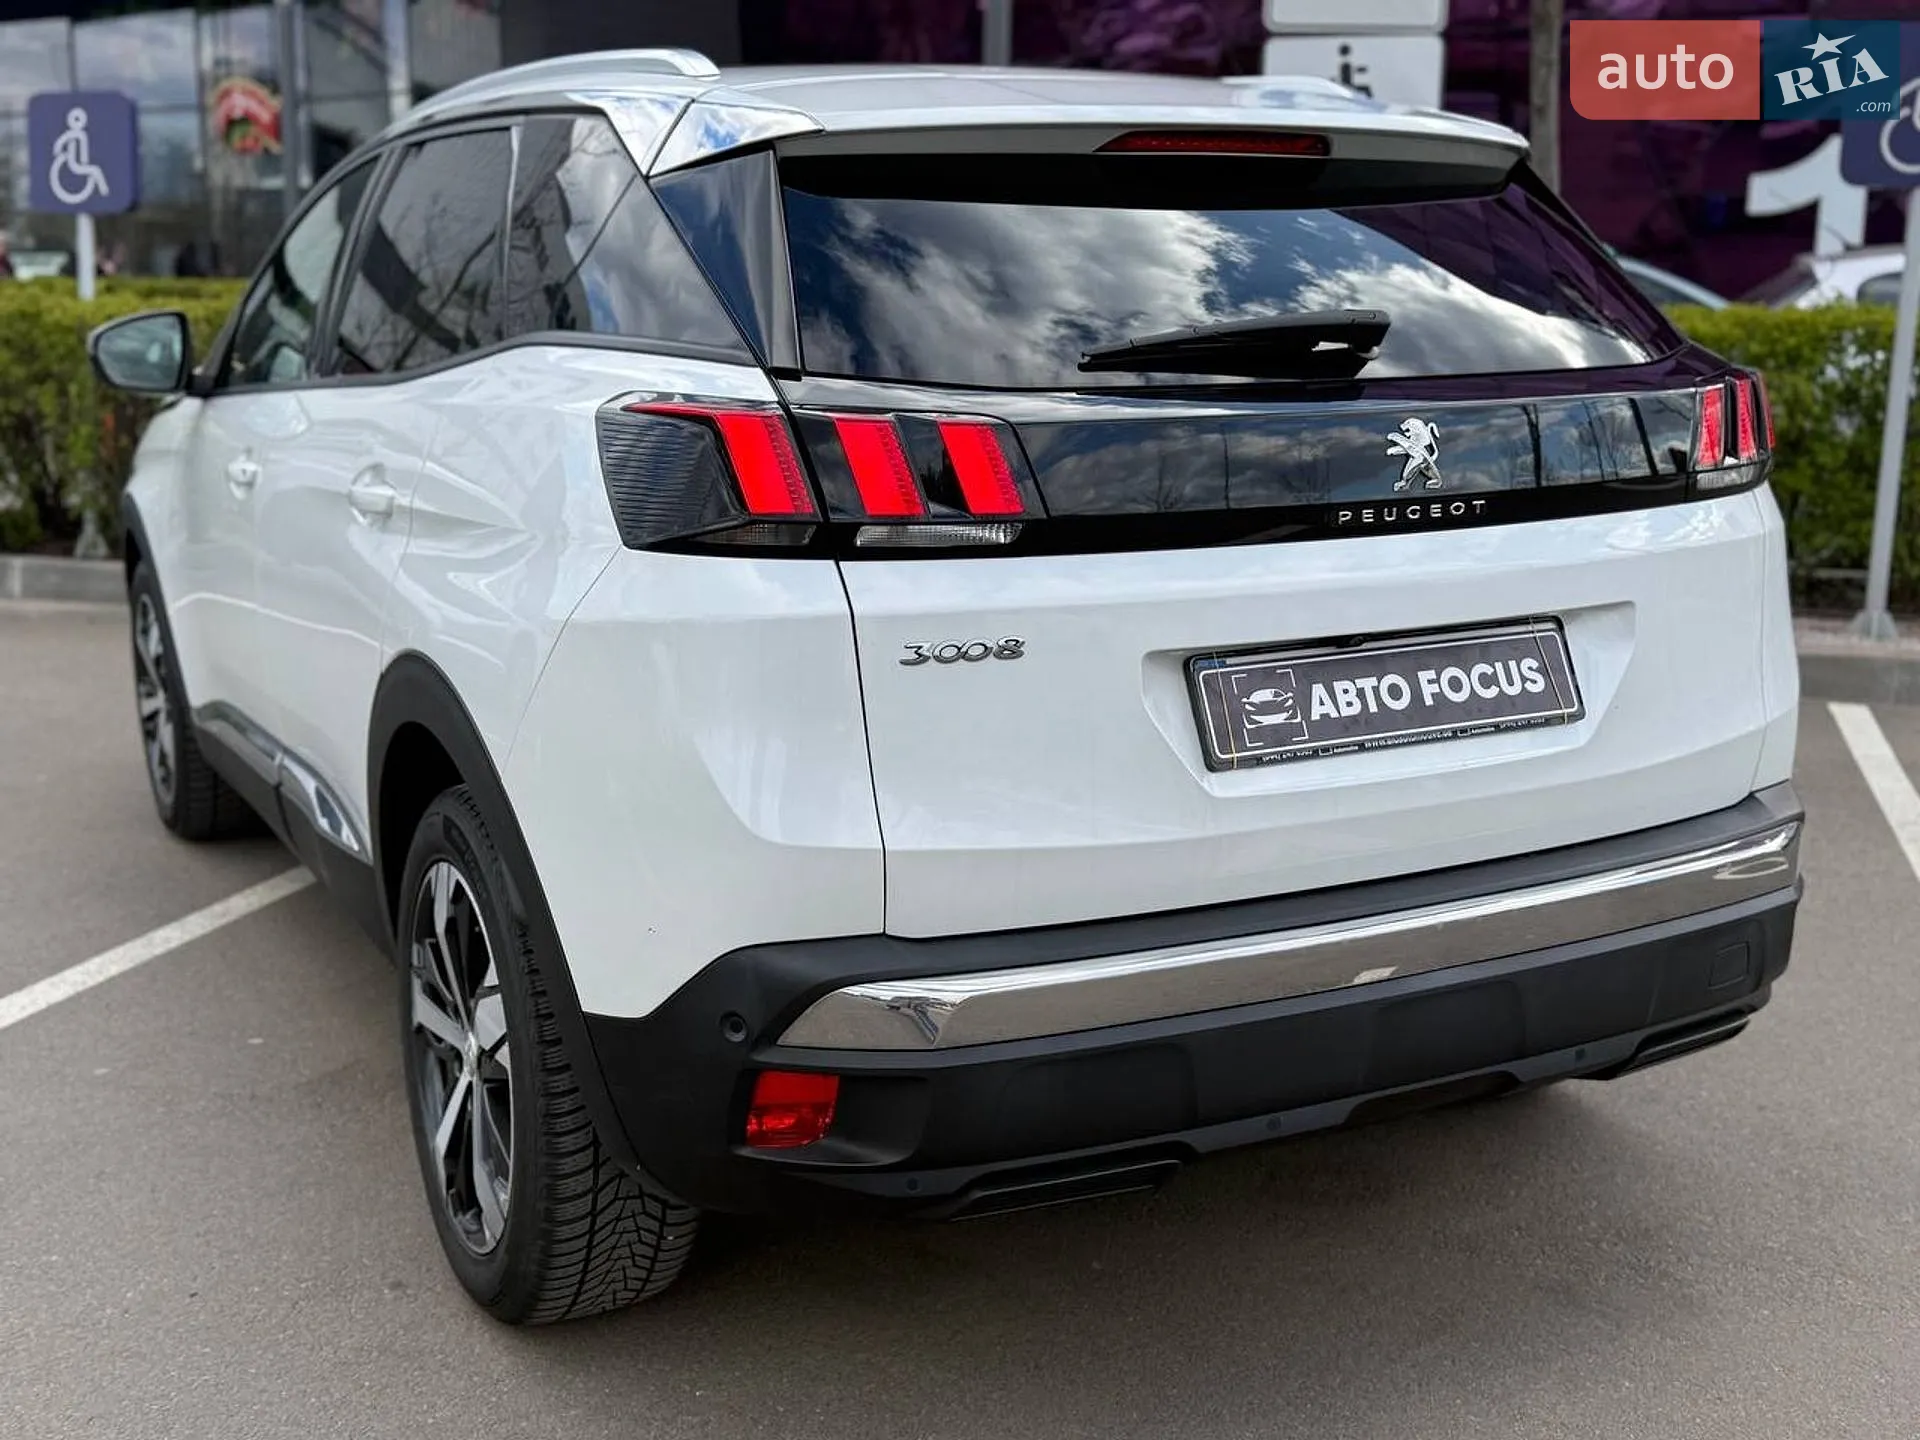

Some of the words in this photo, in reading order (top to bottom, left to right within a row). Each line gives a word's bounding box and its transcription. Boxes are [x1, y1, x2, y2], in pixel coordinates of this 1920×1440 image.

[1745, 133, 1868, 254] 1
[1338, 500, 1486, 525] PEUGEOT
[899, 636, 1025, 666] 3008
[1310, 674, 1411, 720] АВТО
[1417, 658, 1545, 706] FOCUS
